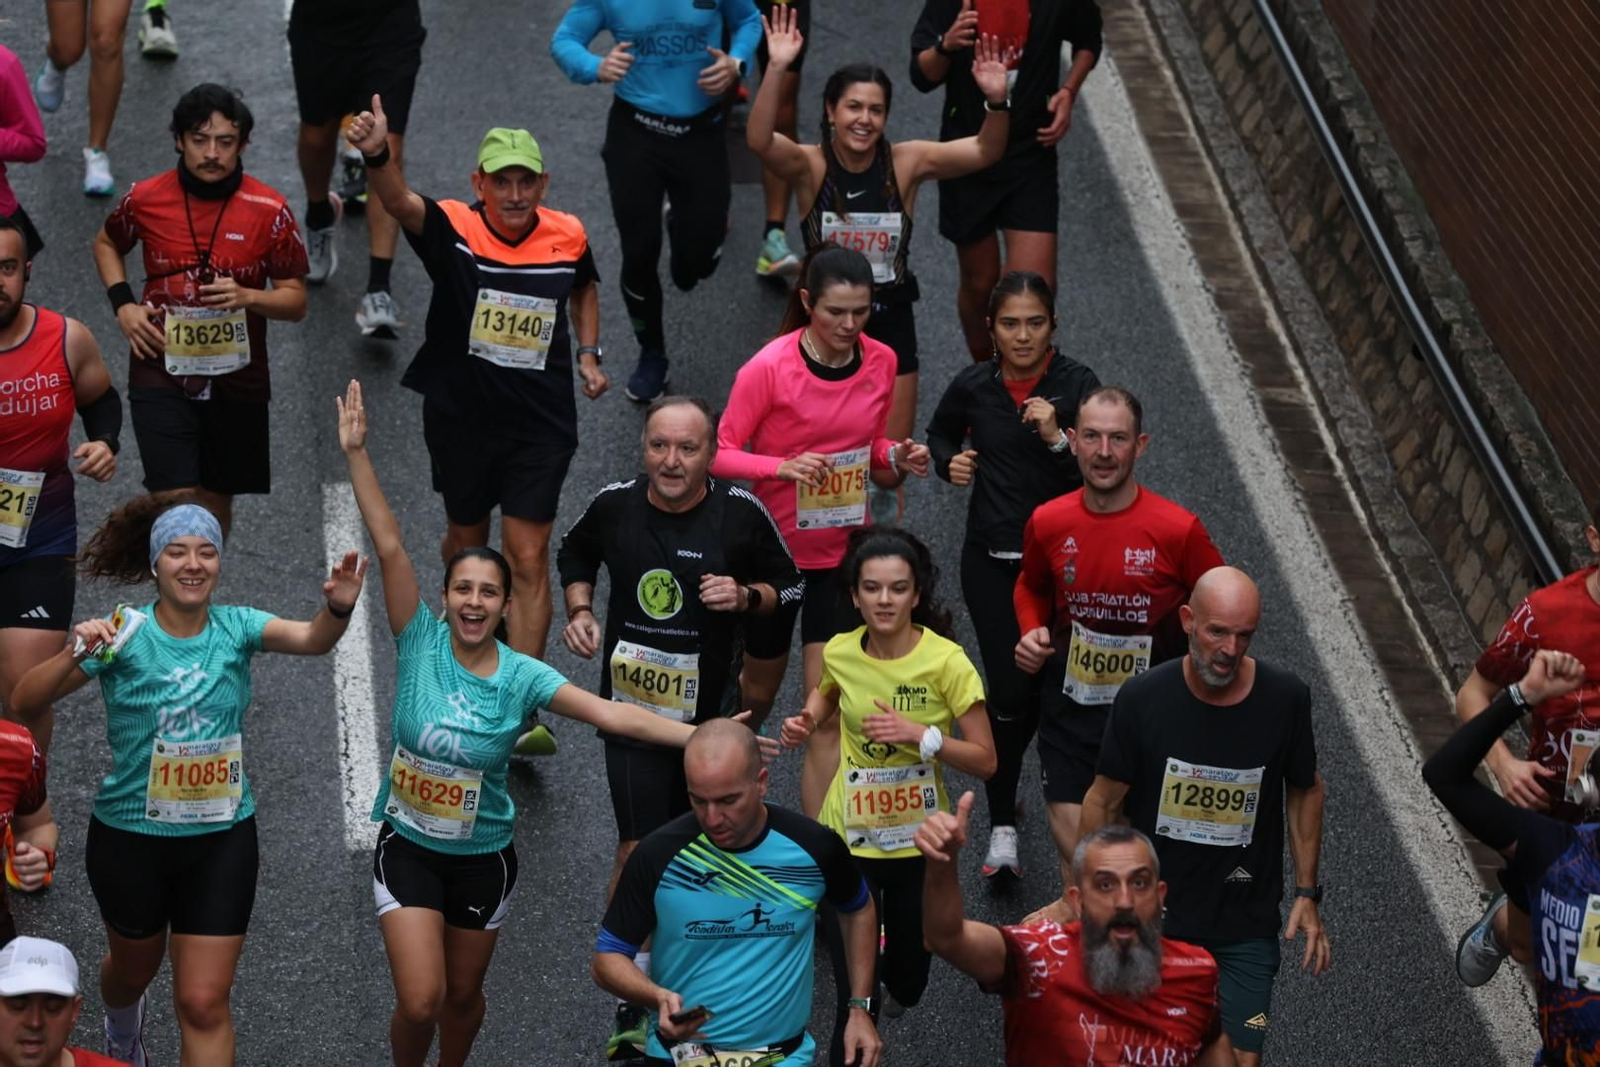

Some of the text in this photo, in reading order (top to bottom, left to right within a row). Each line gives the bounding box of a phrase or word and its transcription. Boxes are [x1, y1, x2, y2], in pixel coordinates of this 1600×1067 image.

[172, 322, 234, 346] 13629
[482, 308, 543, 338] 13140
[0, 371, 60, 395] orcha
[0, 393, 59, 417] dújar
[808, 468, 864, 497] 12075
[1074, 644, 1135, 674] 14600
[618, 662, 683, 696] 14801
[159, 759, 229, 787] 11085
[398, 769, 463, 807] 11629
[852, 784, 922, 815] 11955
[1171, 782, 1245, 811] 12899
[1540, 887, 1580, 930] MEDIO
[27, 956, 48, 967] edp
[1541, 916, 1582, 989] SE
